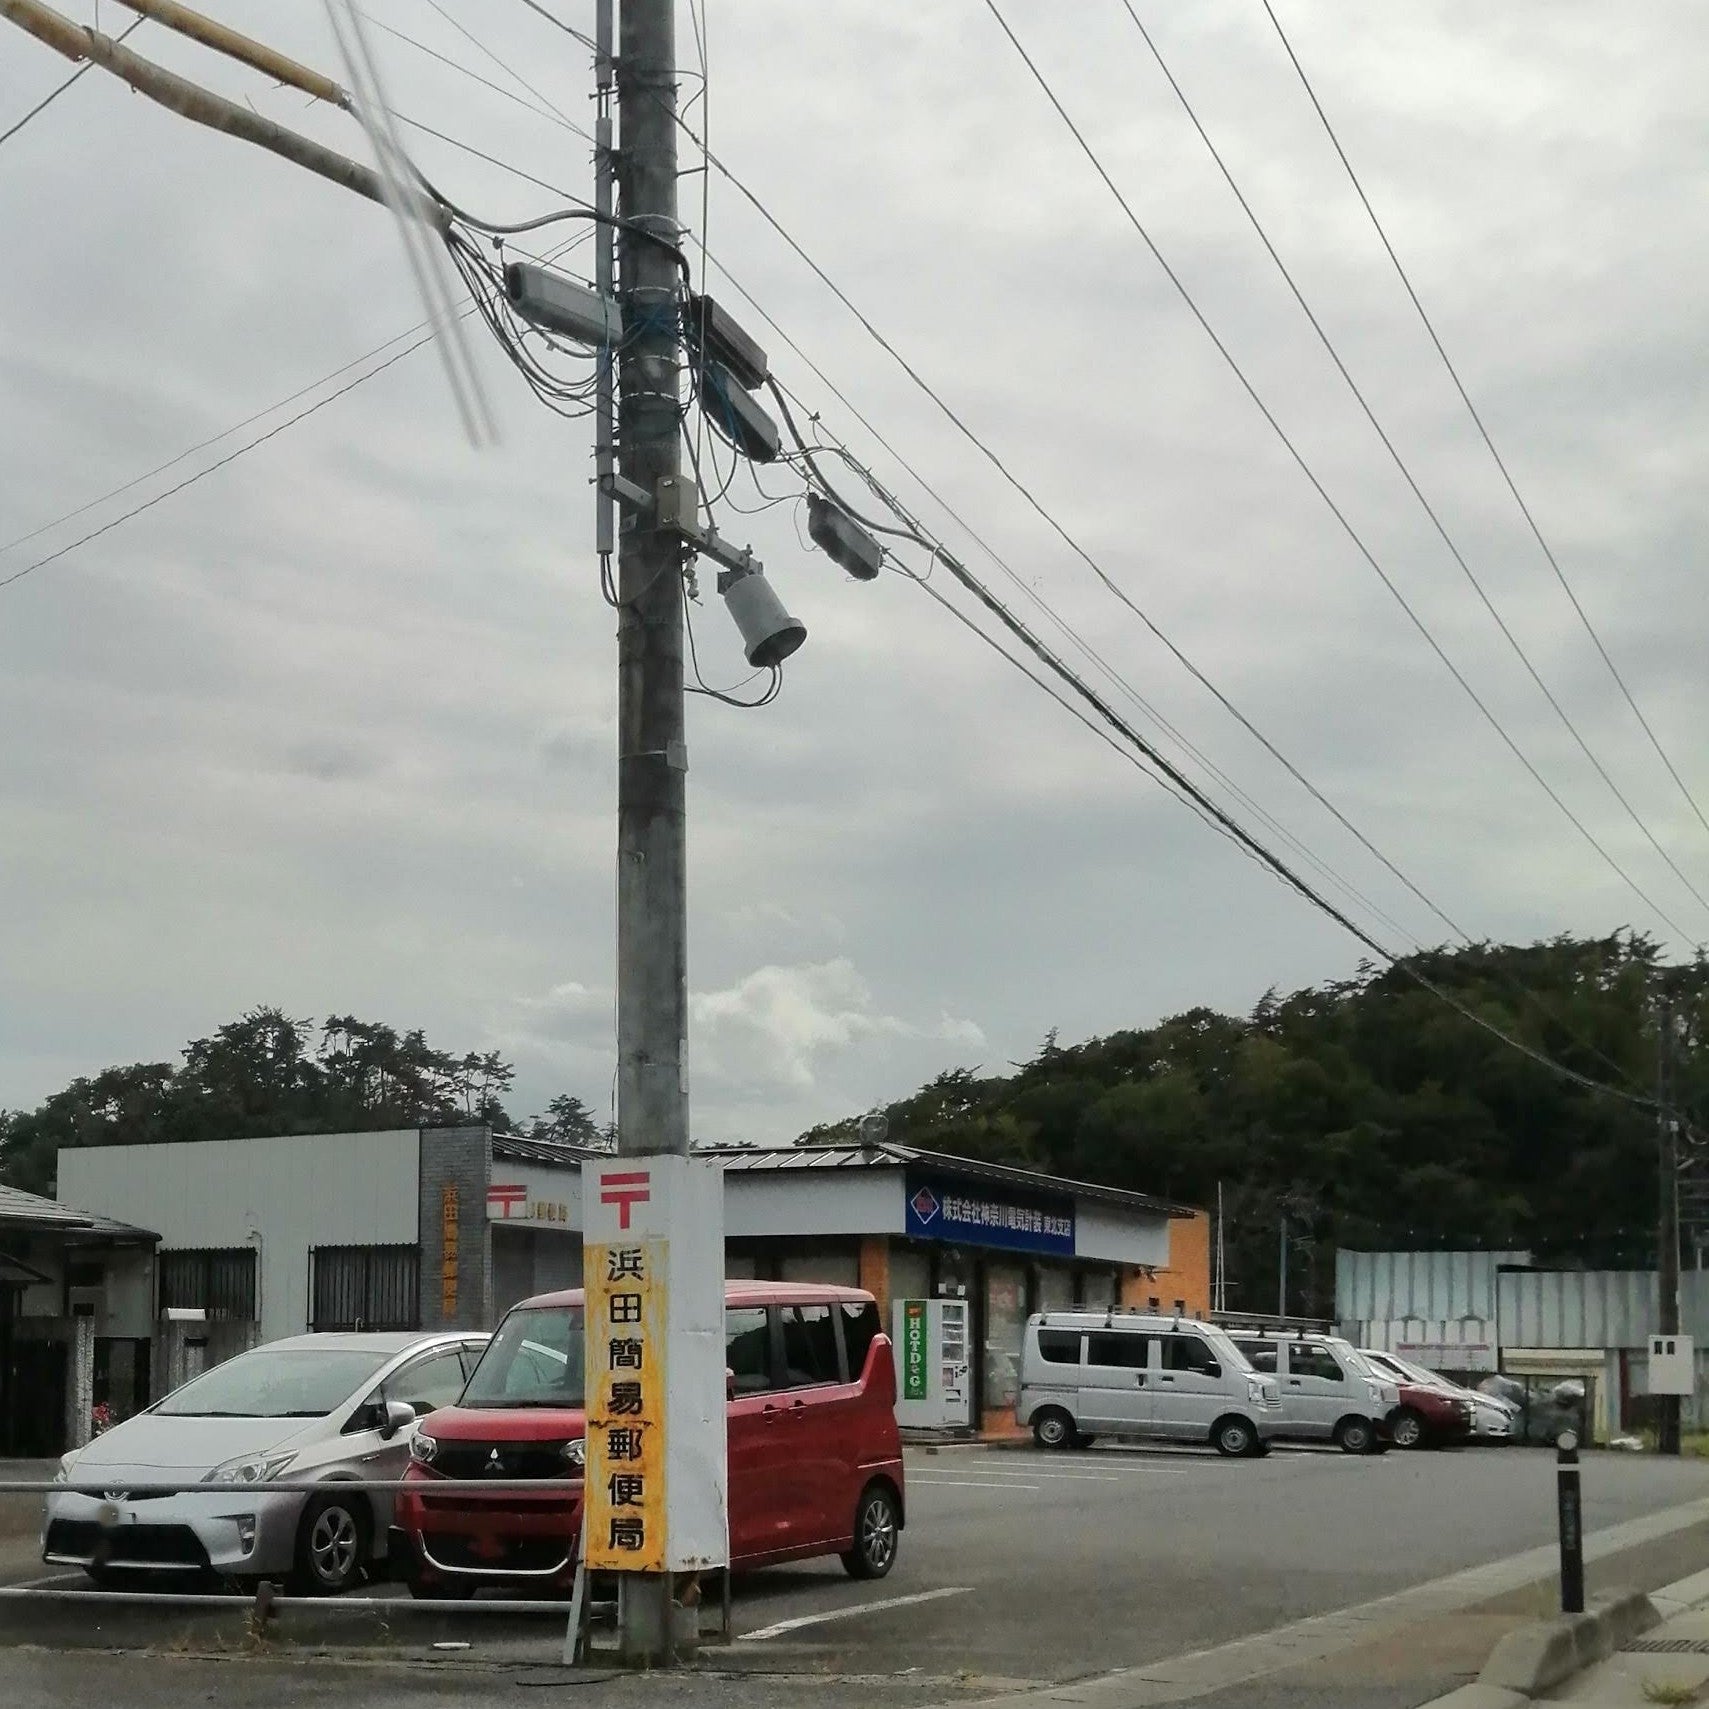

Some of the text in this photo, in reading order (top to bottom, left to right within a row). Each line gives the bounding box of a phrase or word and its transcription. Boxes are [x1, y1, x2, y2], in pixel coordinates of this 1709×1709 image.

[607, 1249, 643, 1550] 浜田簡易郵便局
